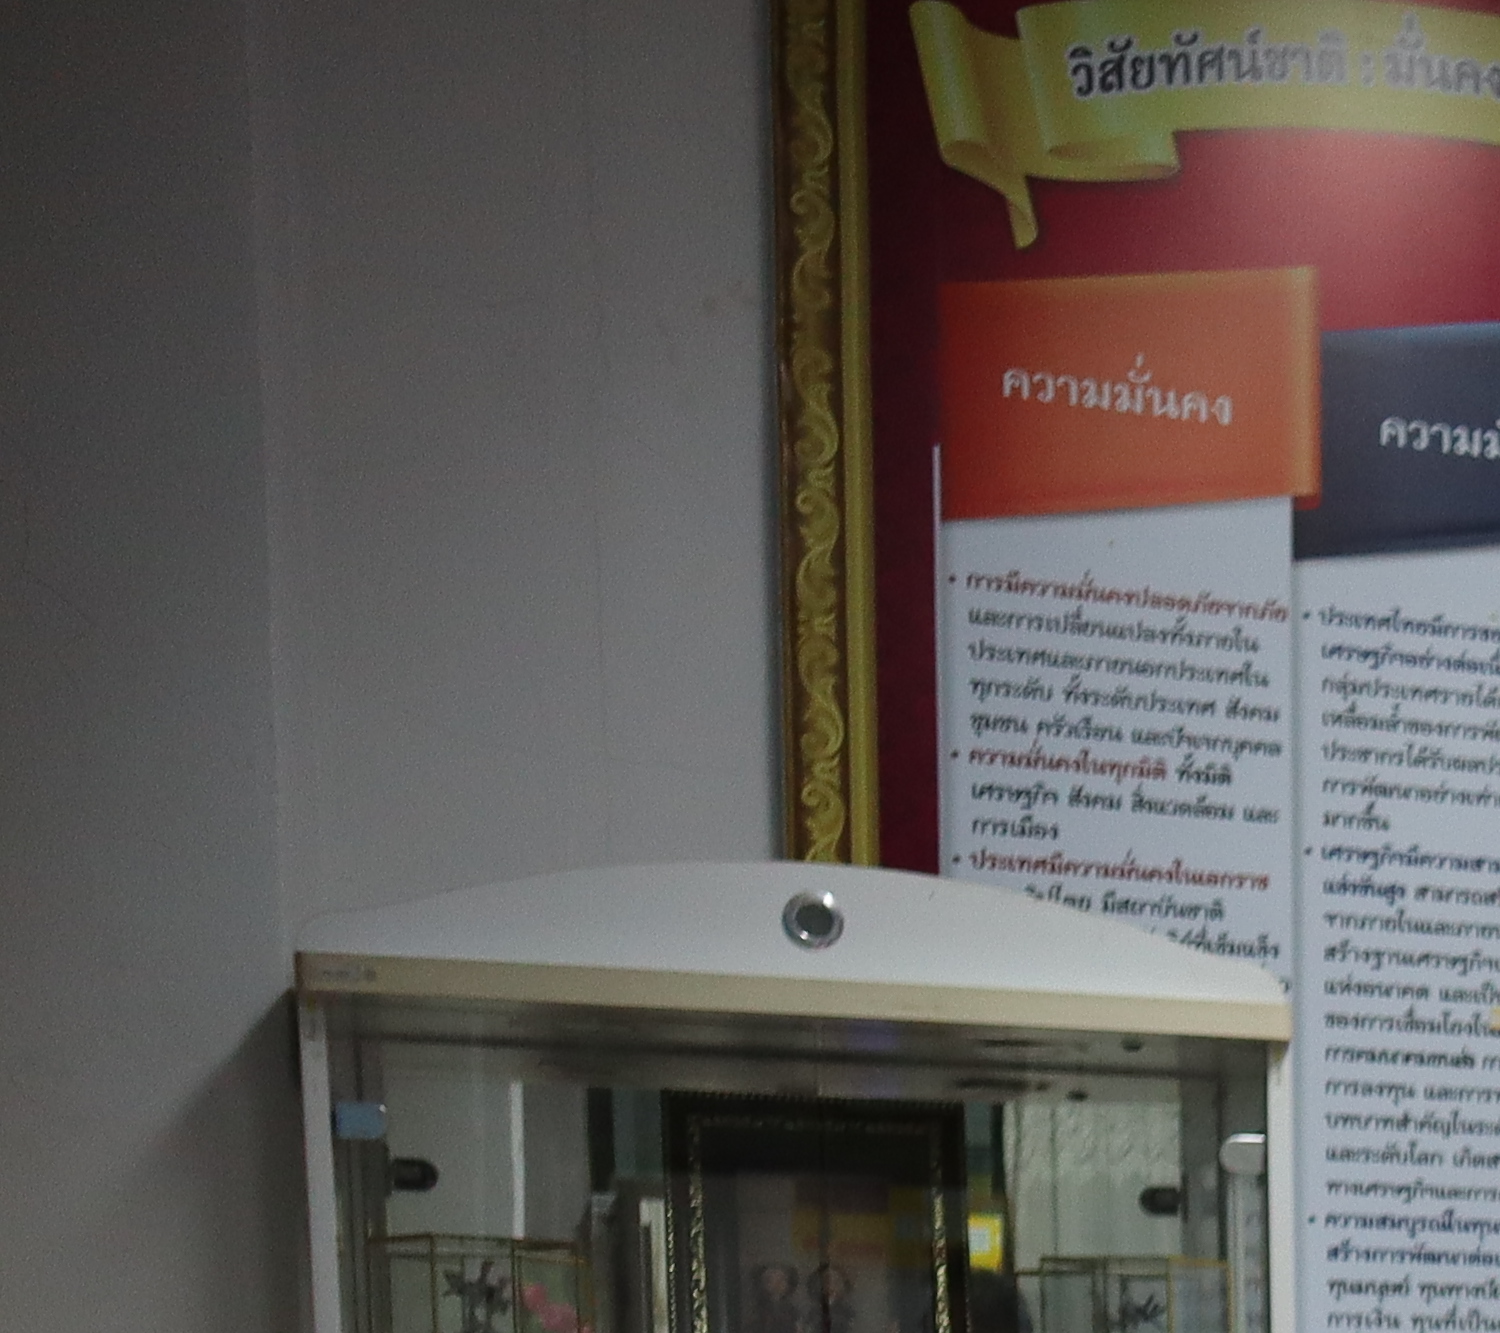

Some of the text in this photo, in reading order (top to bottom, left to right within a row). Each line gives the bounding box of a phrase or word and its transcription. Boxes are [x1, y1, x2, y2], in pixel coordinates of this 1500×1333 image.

[1069, 25, 1349, 100] วิสัยทัศน์ชาติ
[1001, 353, 1233, 427] ความมั่นคง
